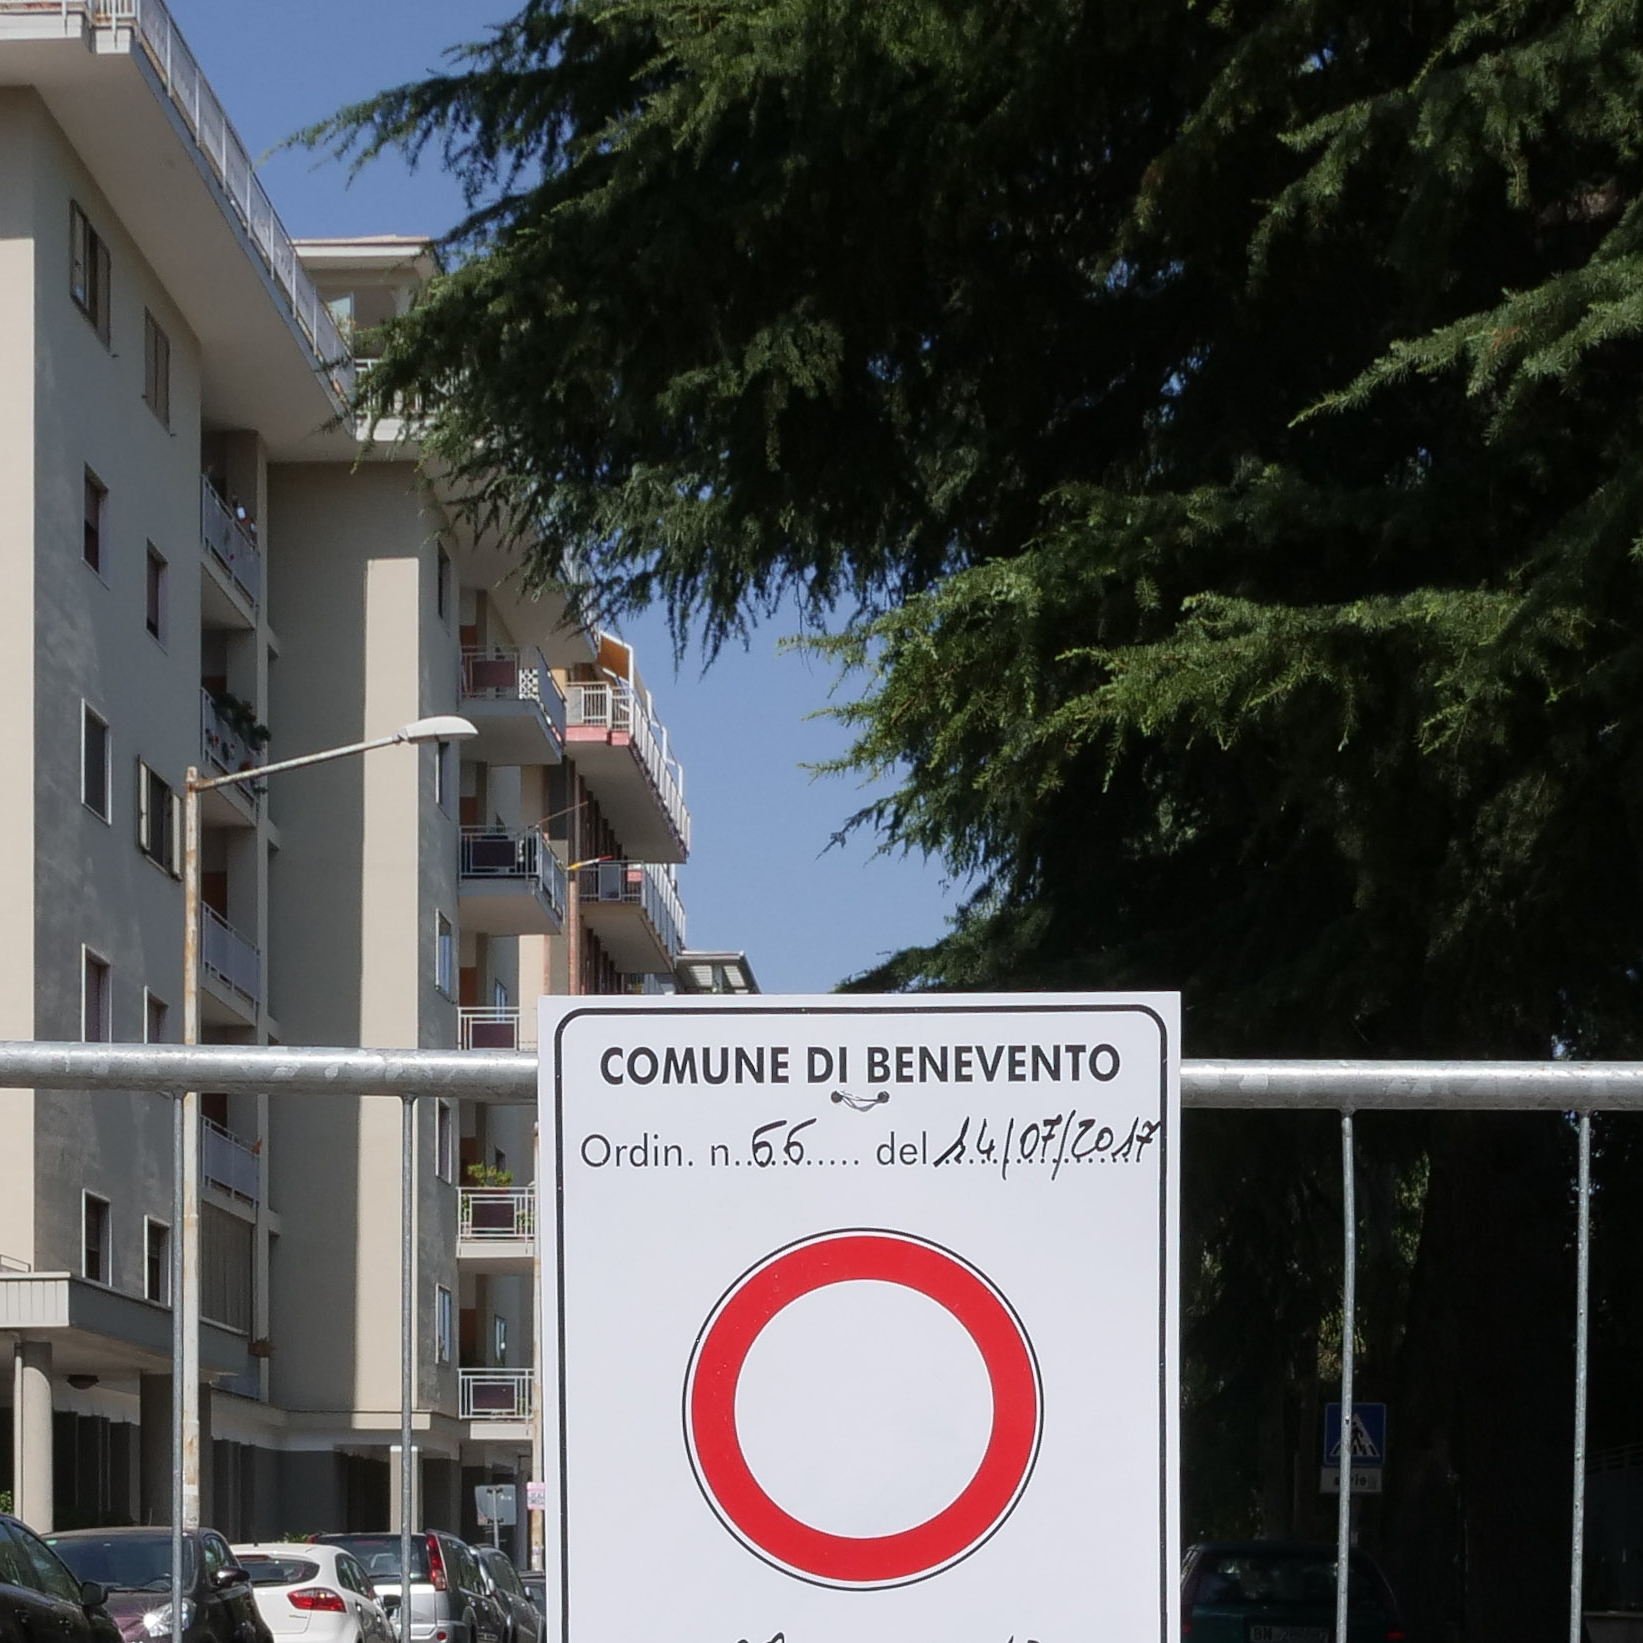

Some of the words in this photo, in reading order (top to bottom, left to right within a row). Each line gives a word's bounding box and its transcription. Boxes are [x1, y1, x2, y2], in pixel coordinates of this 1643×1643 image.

[600, 1046, 789, 1085] COMUNE
[807, 1046, 848, 1083] DI
[867, 1043, 1120, 1084] BENEVENTO
[580, 1132, 693, 1168] Ordin.
[876, 1130, 927, 1166] del
[933, 1109, 1161, 1181] 14/07/2017
